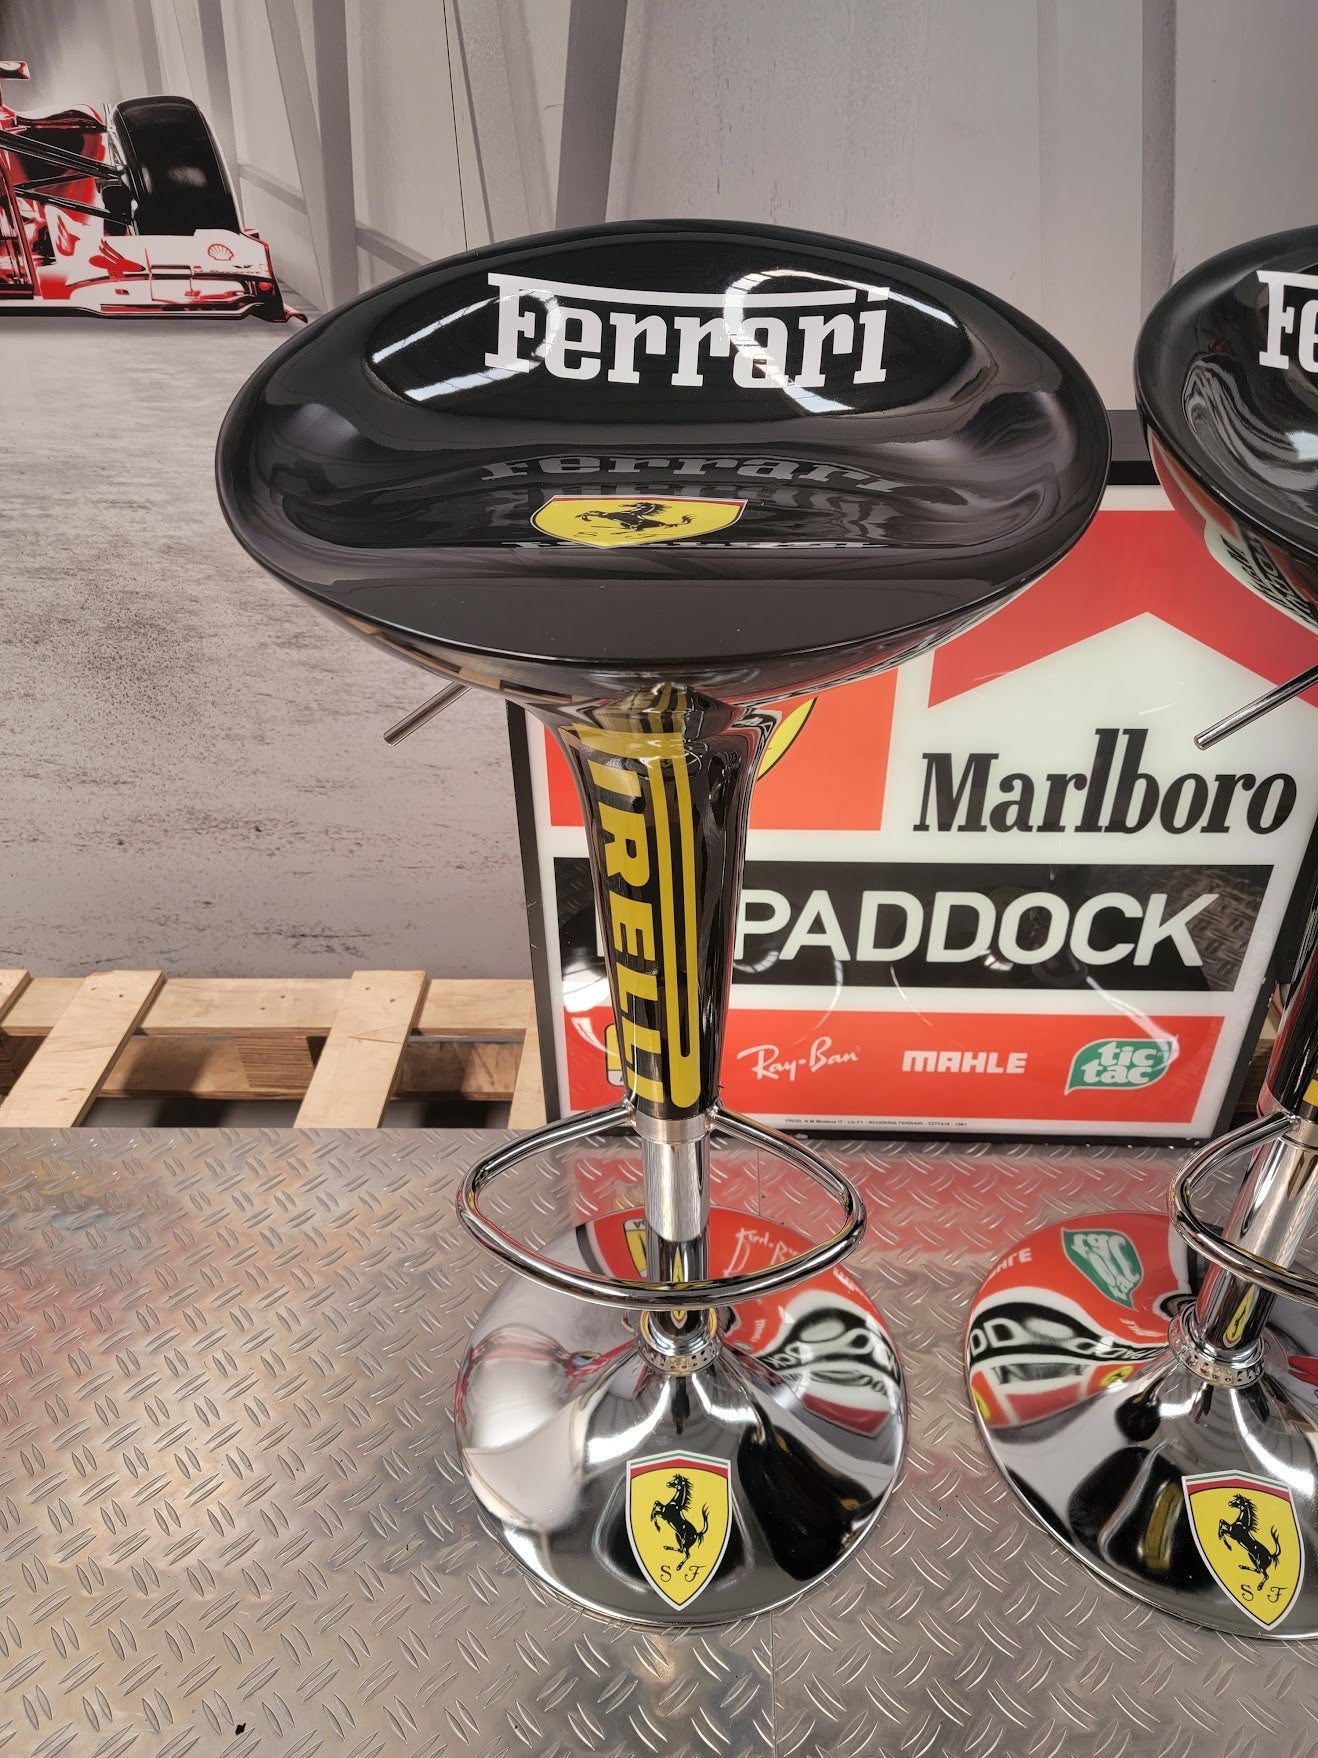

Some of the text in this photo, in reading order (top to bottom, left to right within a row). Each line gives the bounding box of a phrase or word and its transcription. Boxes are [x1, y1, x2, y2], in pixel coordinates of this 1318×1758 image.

[485, 272, 890, 389] Ferrari
[912, 728, 1298, 835] Marlboro
[734, 889, 1220, 967] PADDOCK
[736, 1036, 859, 1081] Ray-Ban
[902, 1050, 1028, 1074] MAHLE
[1098, 1041, 1157, 1066] tic
[1081, 1060, 1152, 1084] tac
[660, 1565, 672, 1582] S
[1240, 1584, 1254, 1602] S
